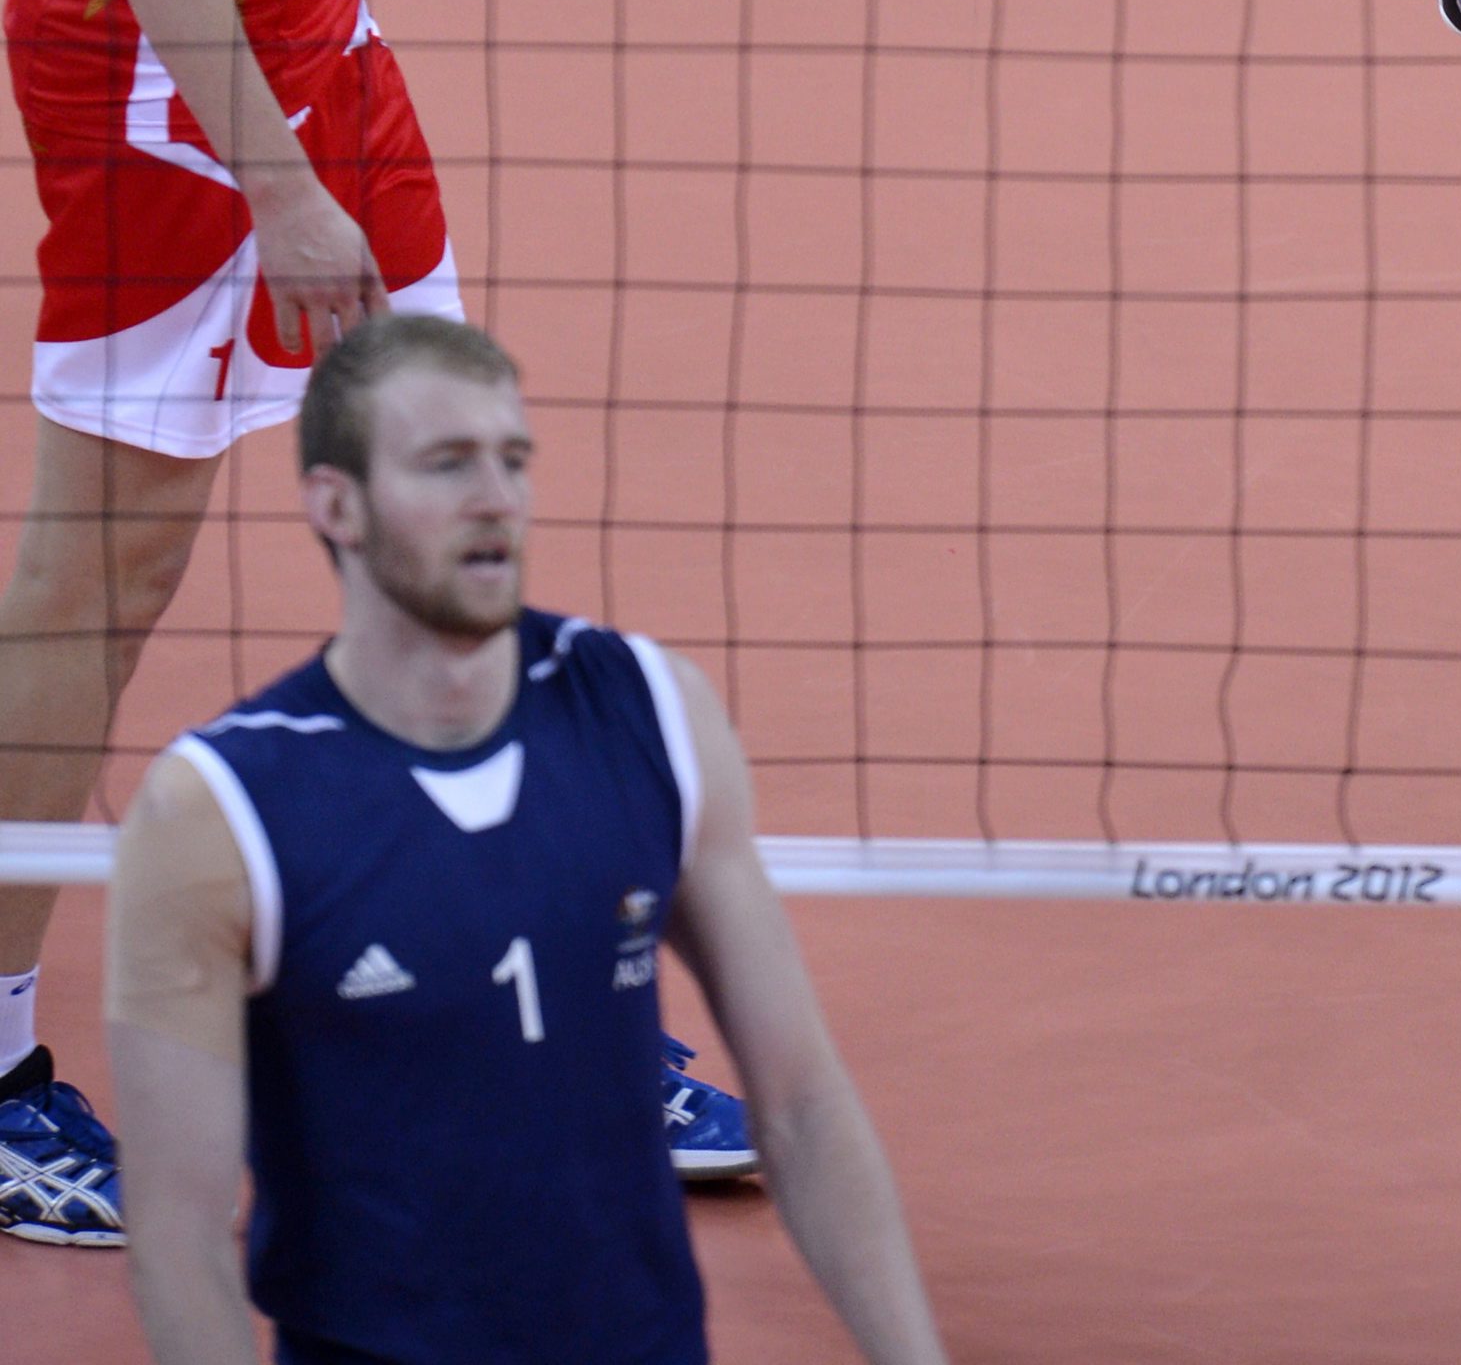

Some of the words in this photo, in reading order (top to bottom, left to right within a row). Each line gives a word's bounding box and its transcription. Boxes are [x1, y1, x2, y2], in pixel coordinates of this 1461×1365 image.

[210, 338, 235, 401] 1
[1131, 861, 1314, 901] London
[1331, 864, 1444, 902] 2012
[491, 936, 545, 1043] 1
